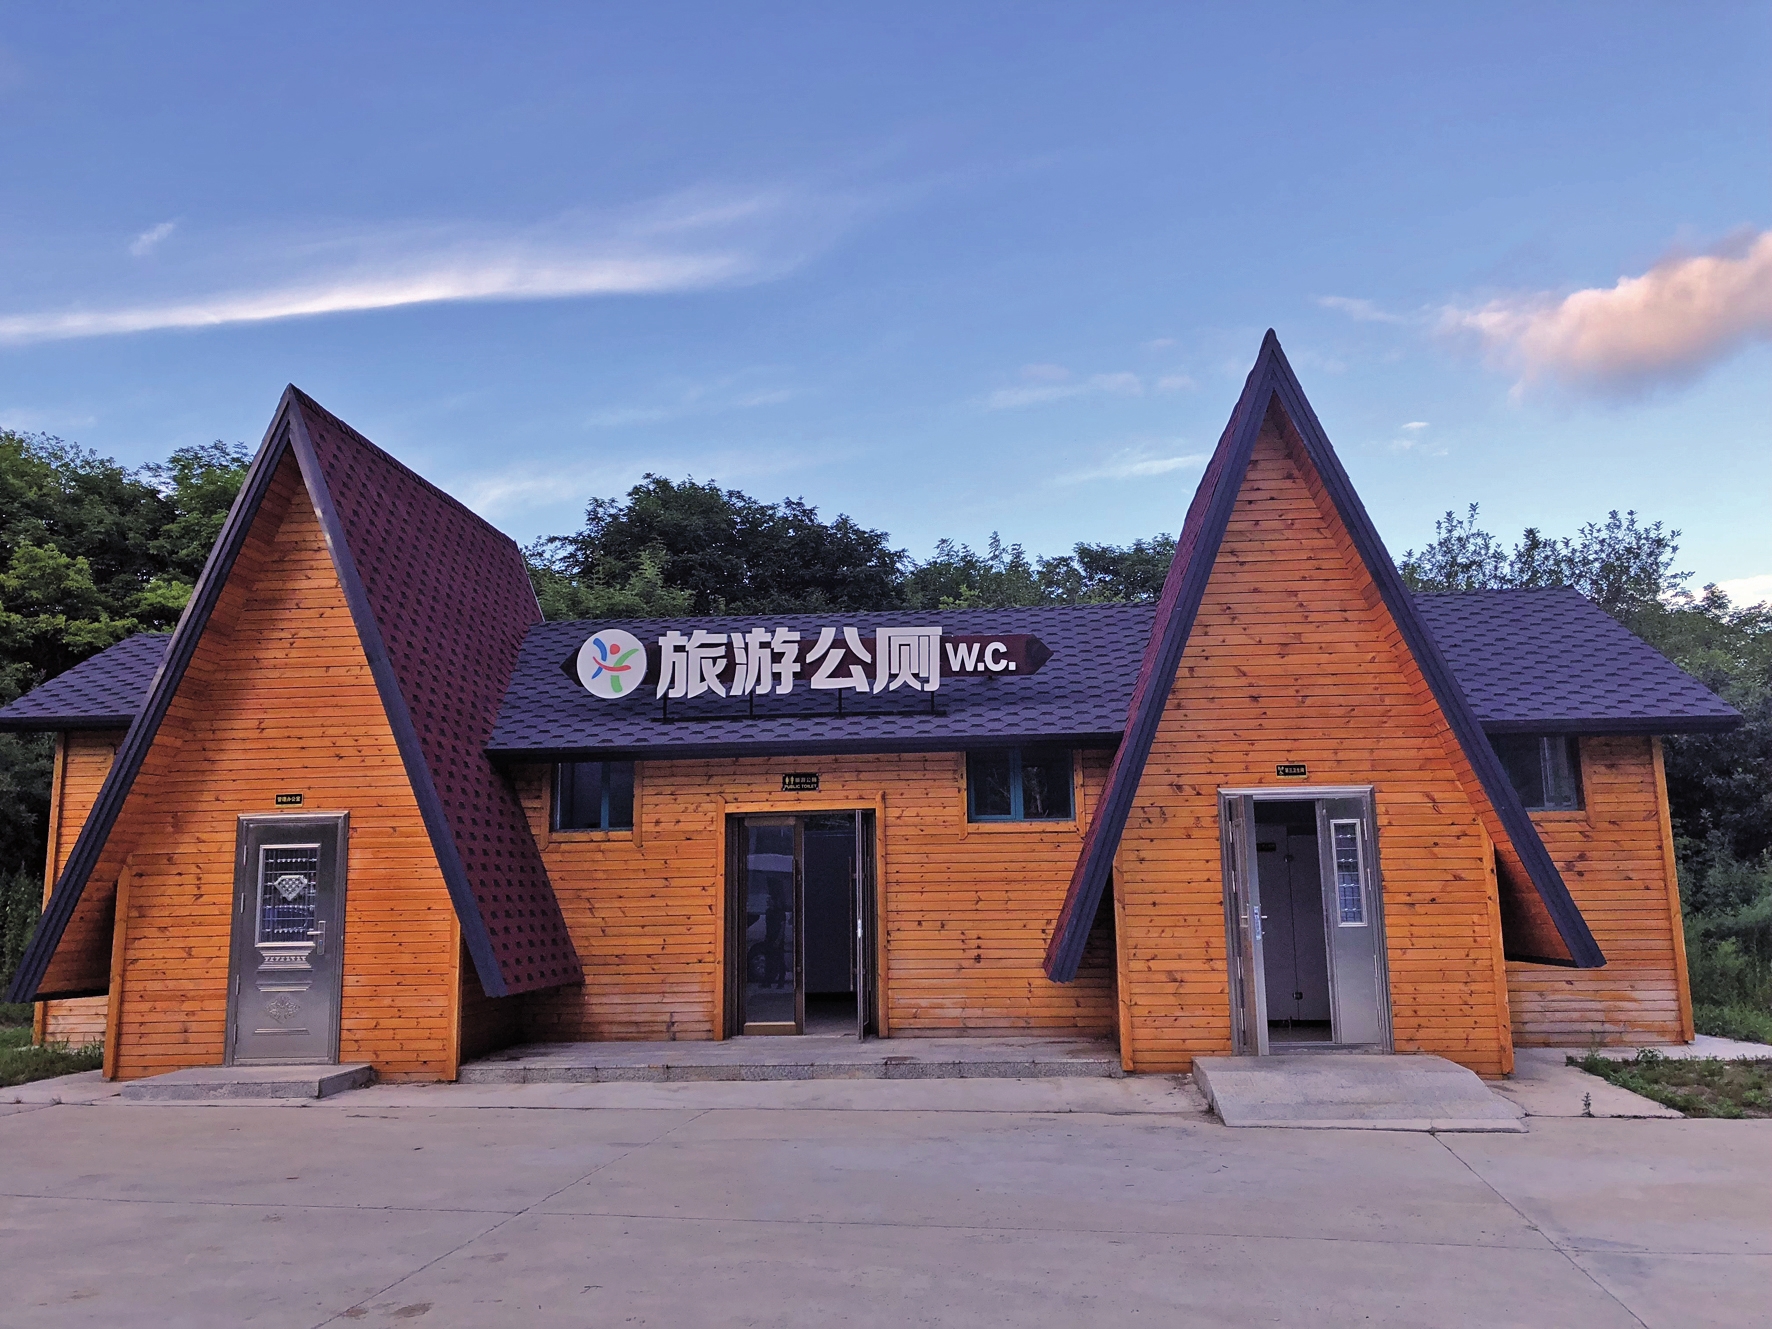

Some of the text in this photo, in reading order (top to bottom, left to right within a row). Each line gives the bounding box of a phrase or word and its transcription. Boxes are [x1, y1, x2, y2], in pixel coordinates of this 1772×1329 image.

[657, 627, 1016, 699] 旅游公厕 W.C.
